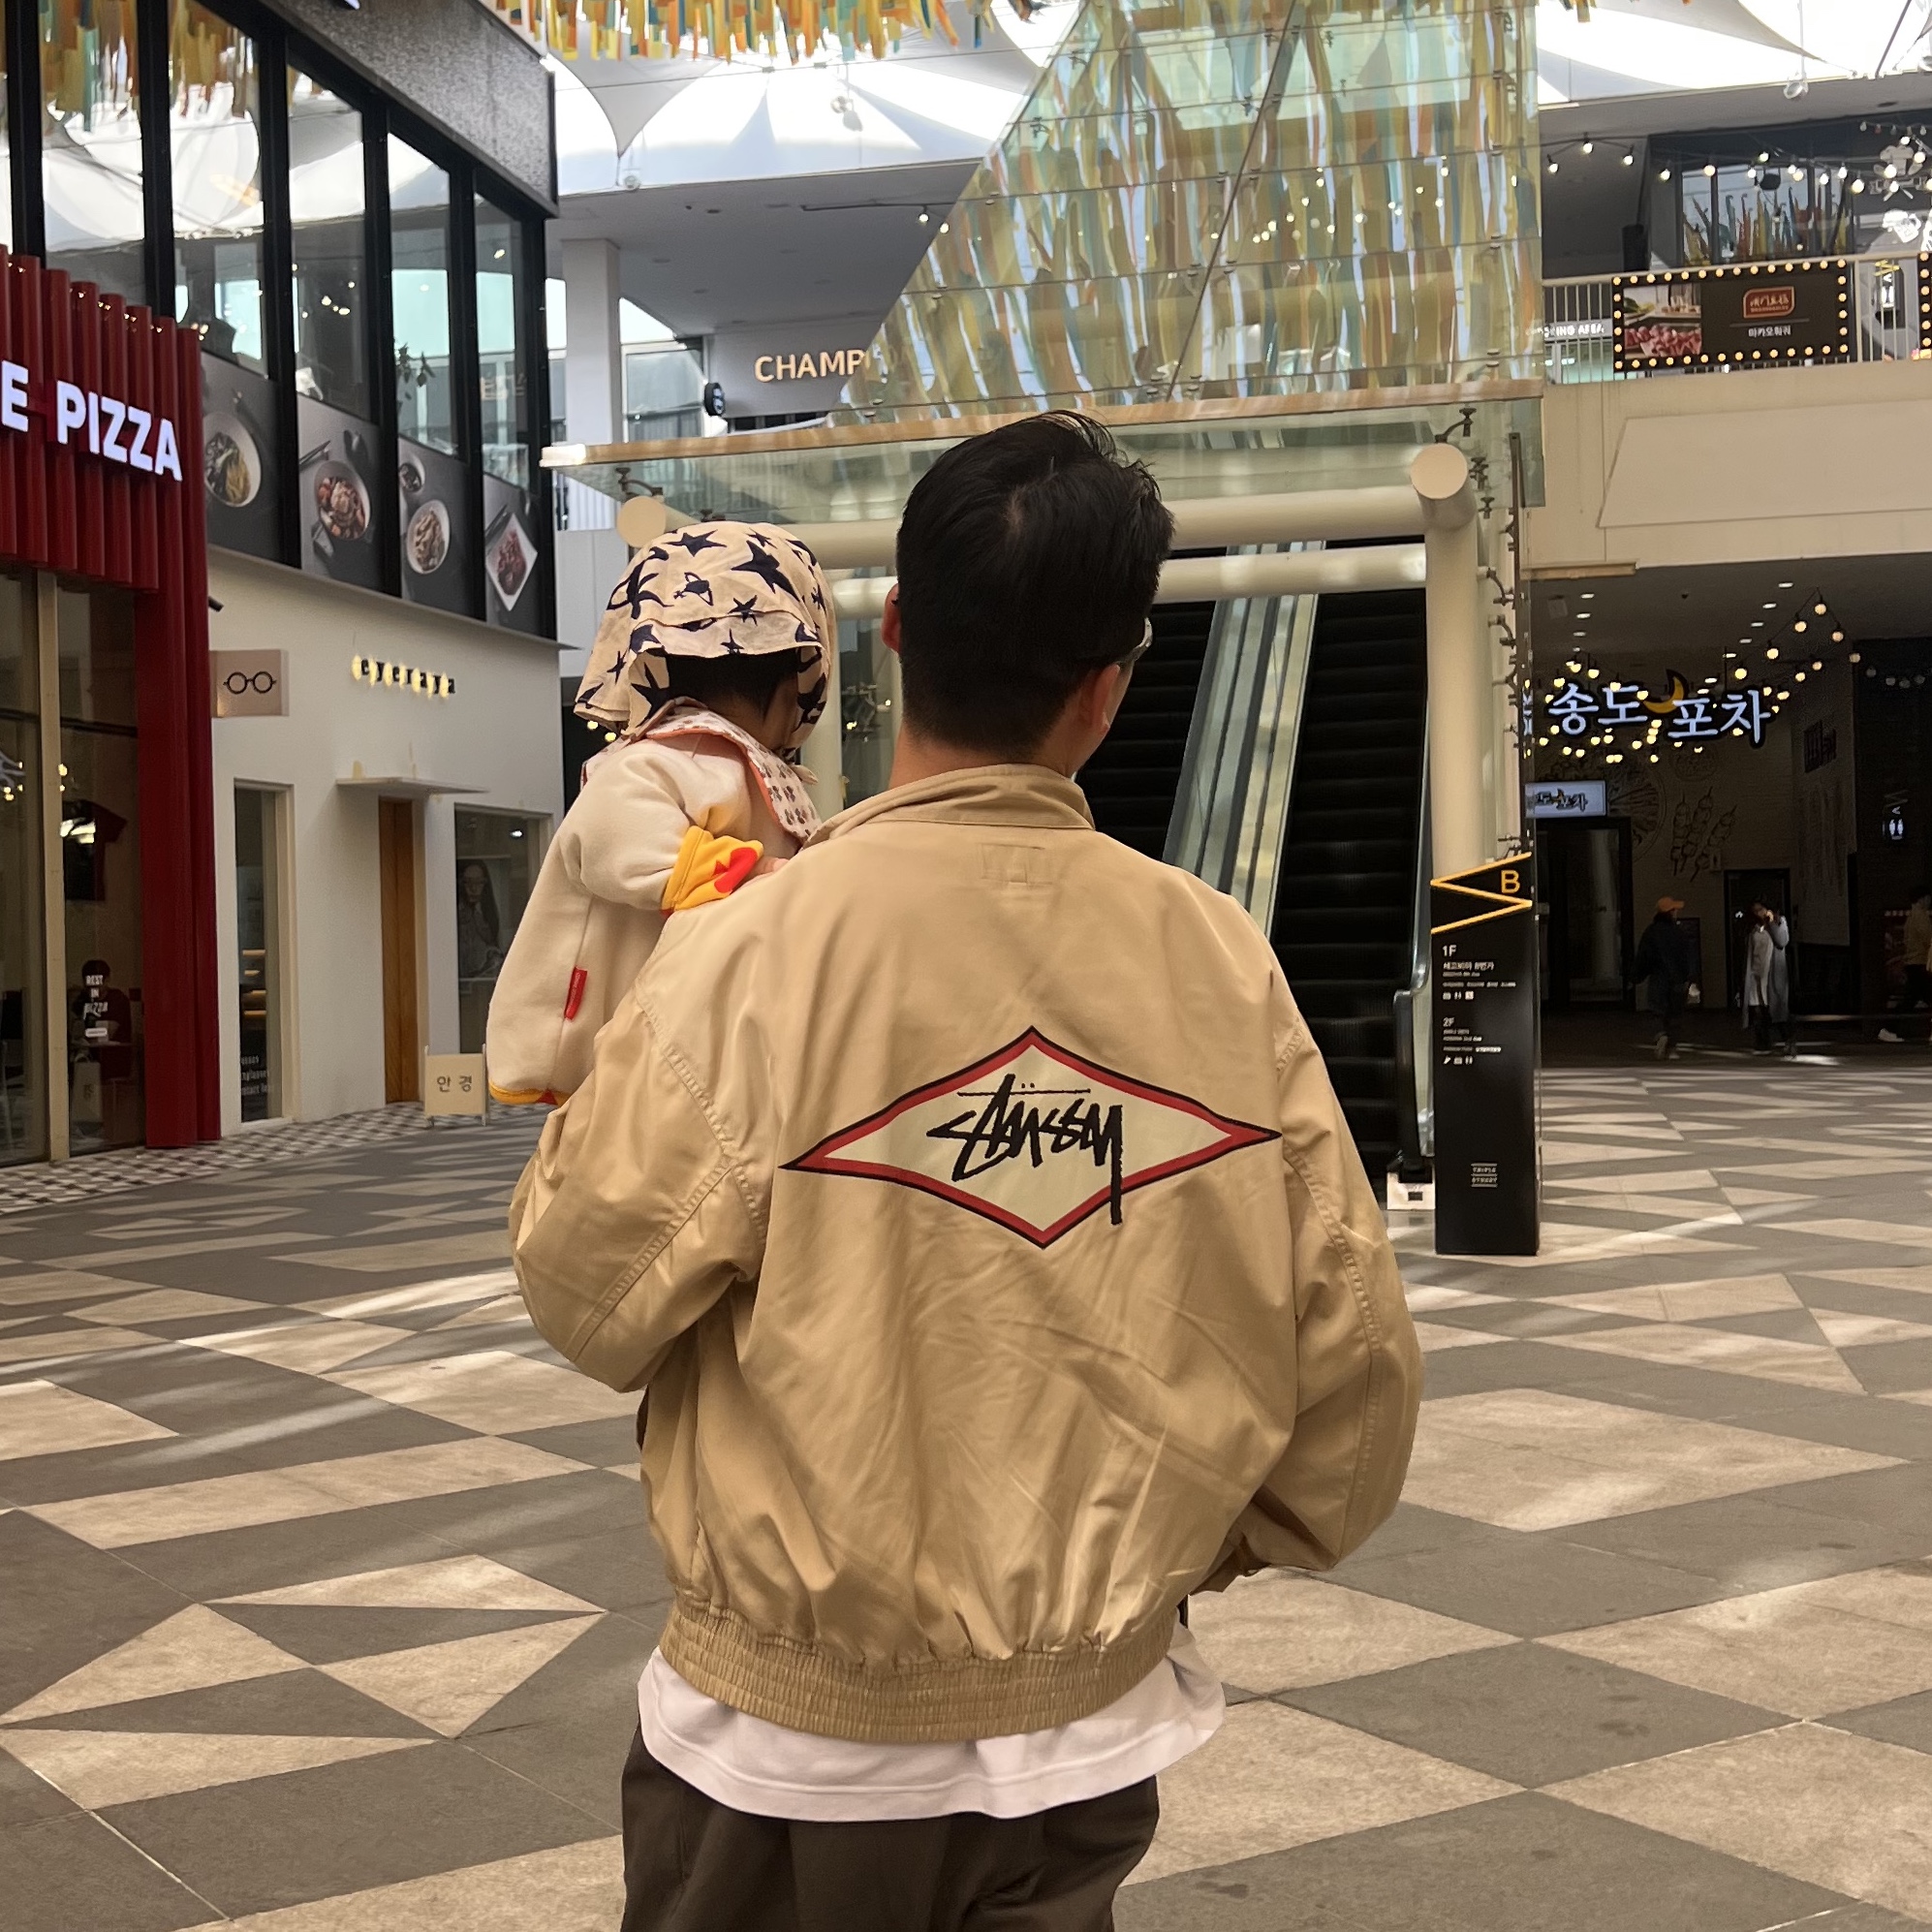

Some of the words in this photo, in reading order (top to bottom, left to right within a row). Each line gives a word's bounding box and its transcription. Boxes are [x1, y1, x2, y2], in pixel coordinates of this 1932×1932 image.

[56, 380, 183, 482] PIZZA
[1548, 682, 1648, 736] 송도
[1667, 689, 1771, 744] 포차
[1500, 870, 1521, 894] B
[1442, 945, 1457, 957] 1F
[1443, 1016, 1455, 1027] 2F
